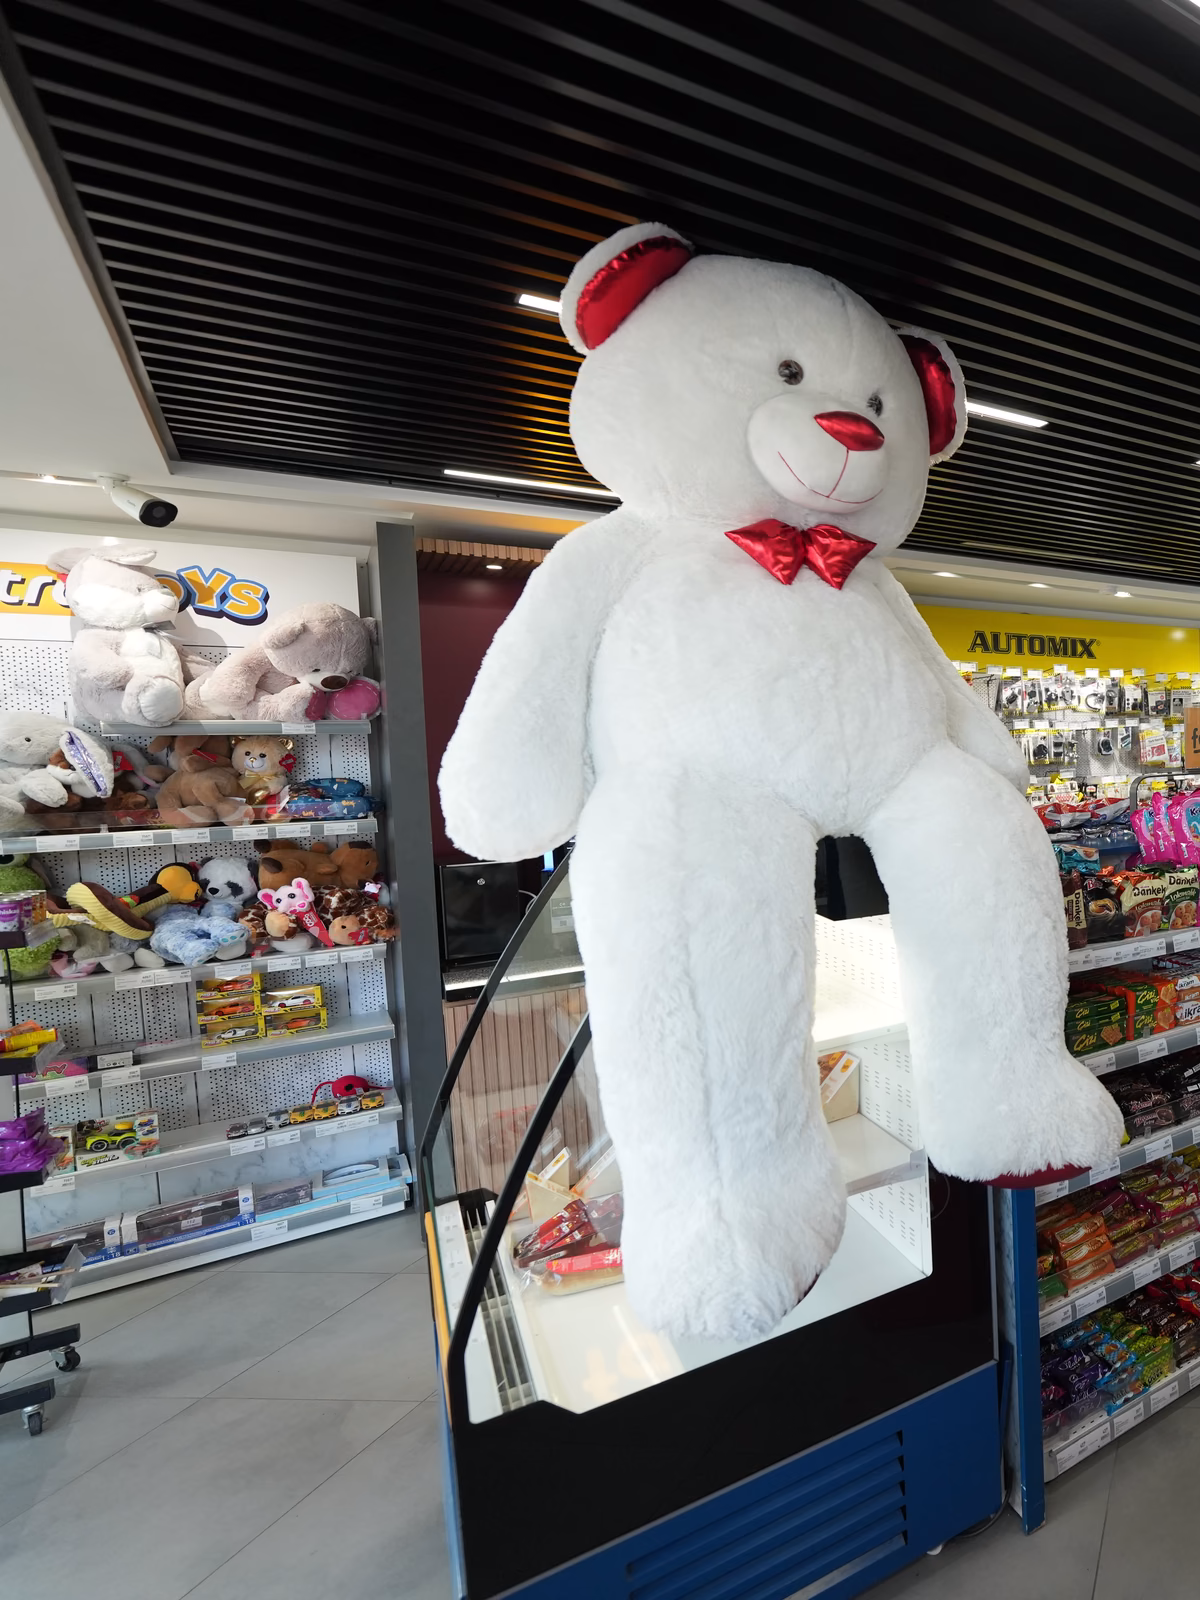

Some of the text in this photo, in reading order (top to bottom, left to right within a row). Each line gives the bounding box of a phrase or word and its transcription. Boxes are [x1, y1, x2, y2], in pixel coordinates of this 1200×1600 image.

[968, 630, 1098, 660] AUTOMIX
[1132, 885, 1167, 898] Dankek
[1074, 892, 1083, 927] Dankek
